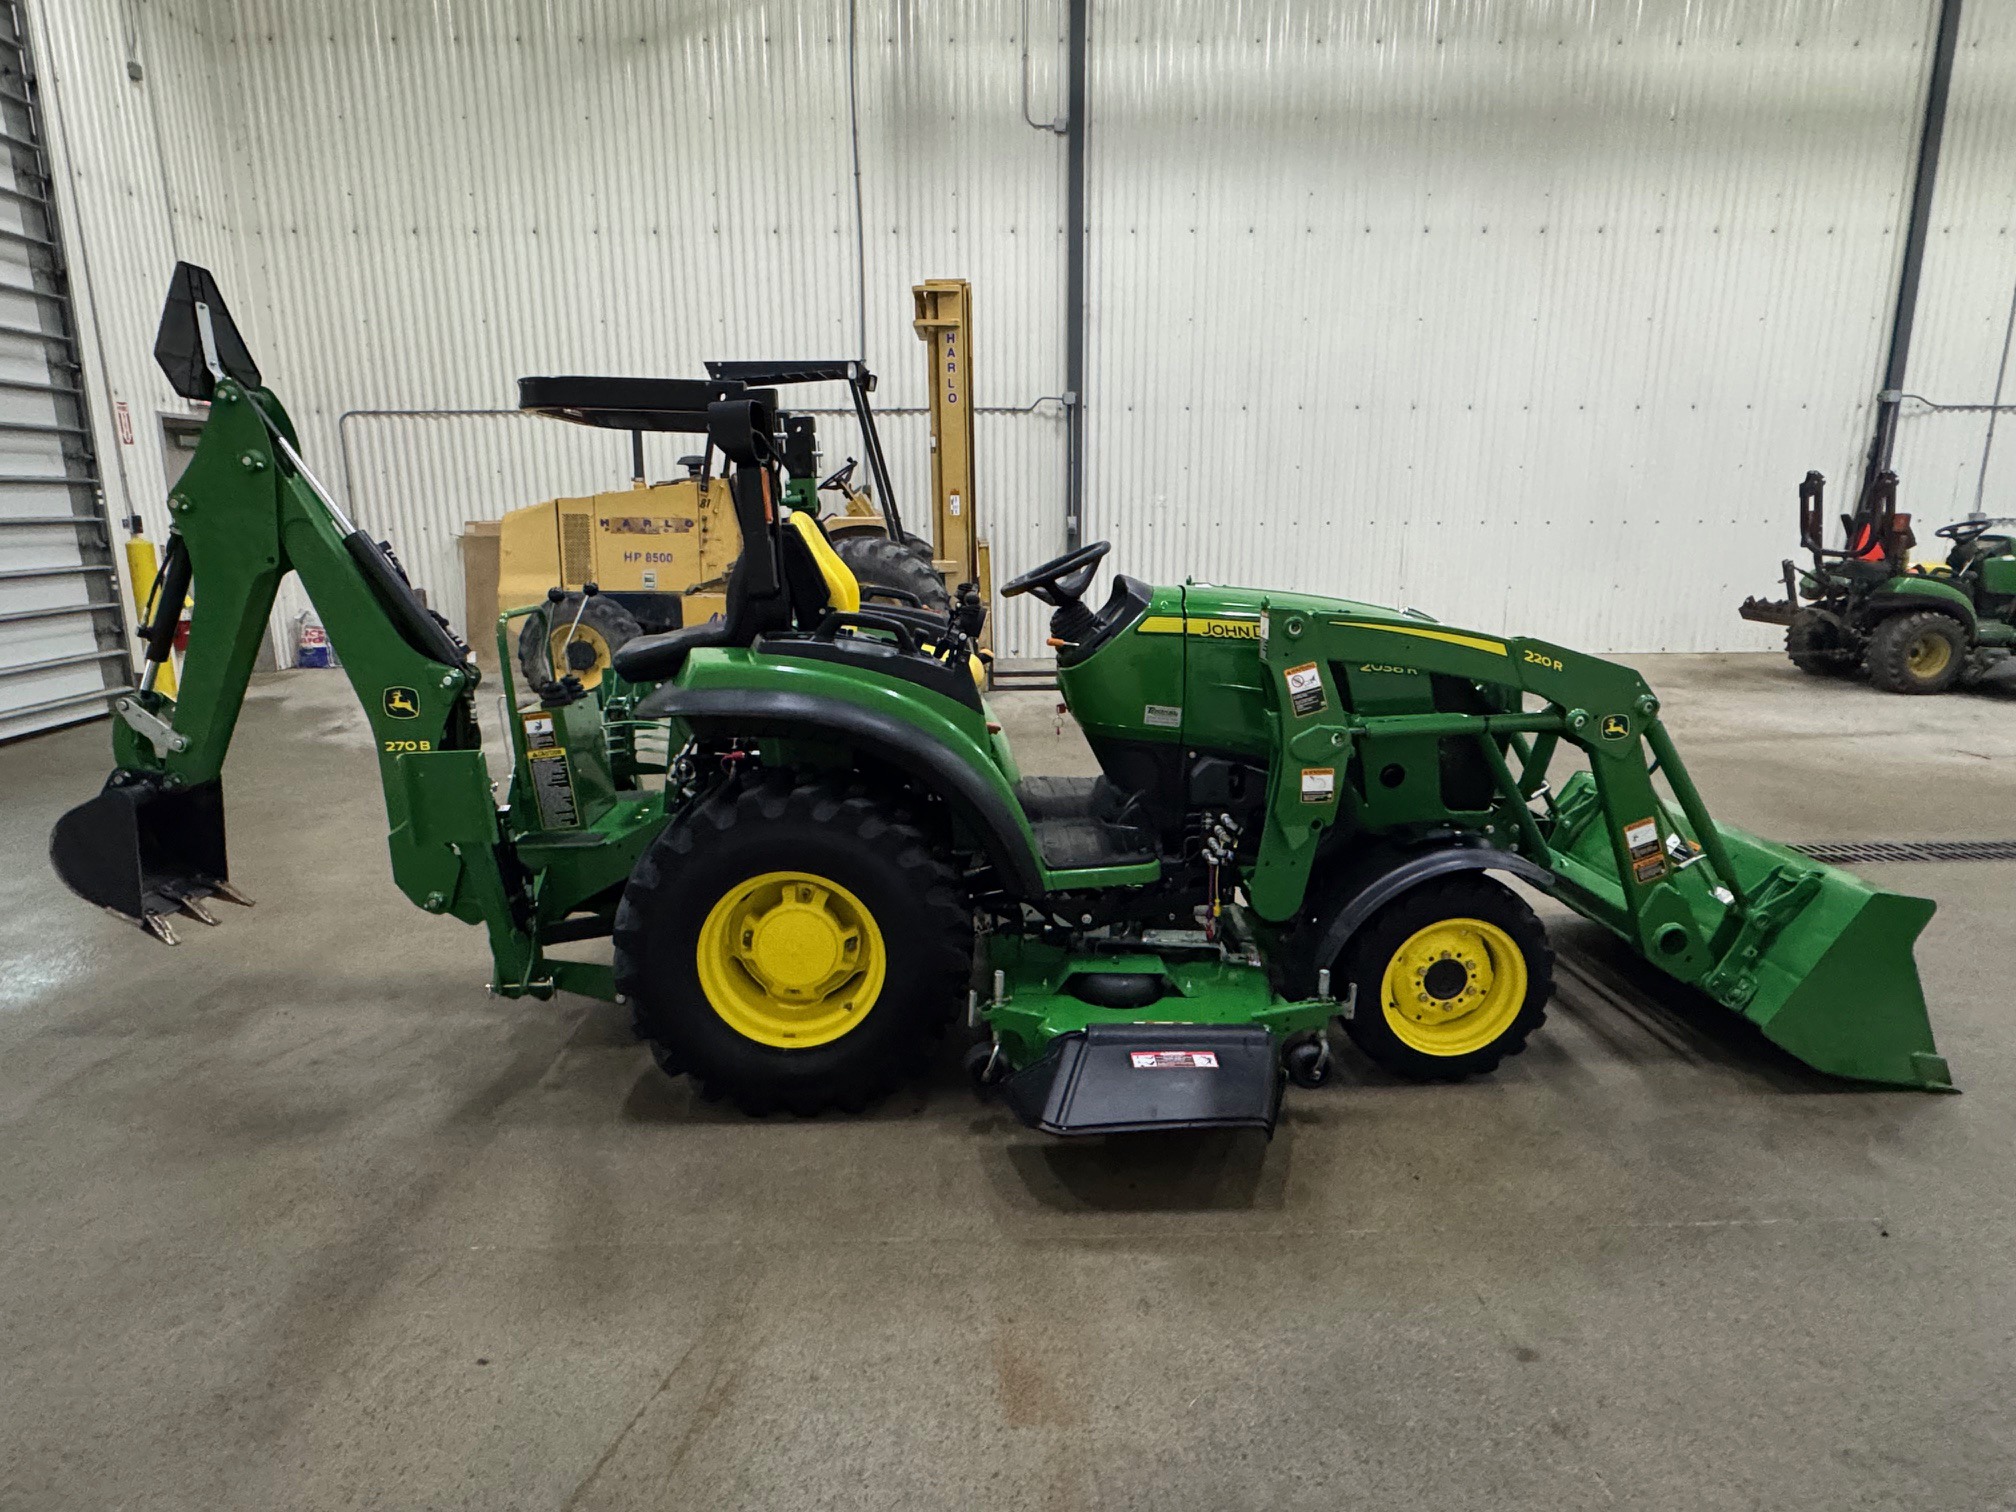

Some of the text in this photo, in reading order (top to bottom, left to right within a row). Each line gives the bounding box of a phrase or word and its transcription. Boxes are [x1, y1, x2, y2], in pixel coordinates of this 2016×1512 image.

[946, 333, 957, 403] HARLO
[600, 518, 694, 528] HARLO
[624, 552, 673, 563] HP 8500
[1202, 622, 1250, 637] JOHN
[1524, 650, 1563, 672] 220 R
[385, 740, 431, 751] 270 B
